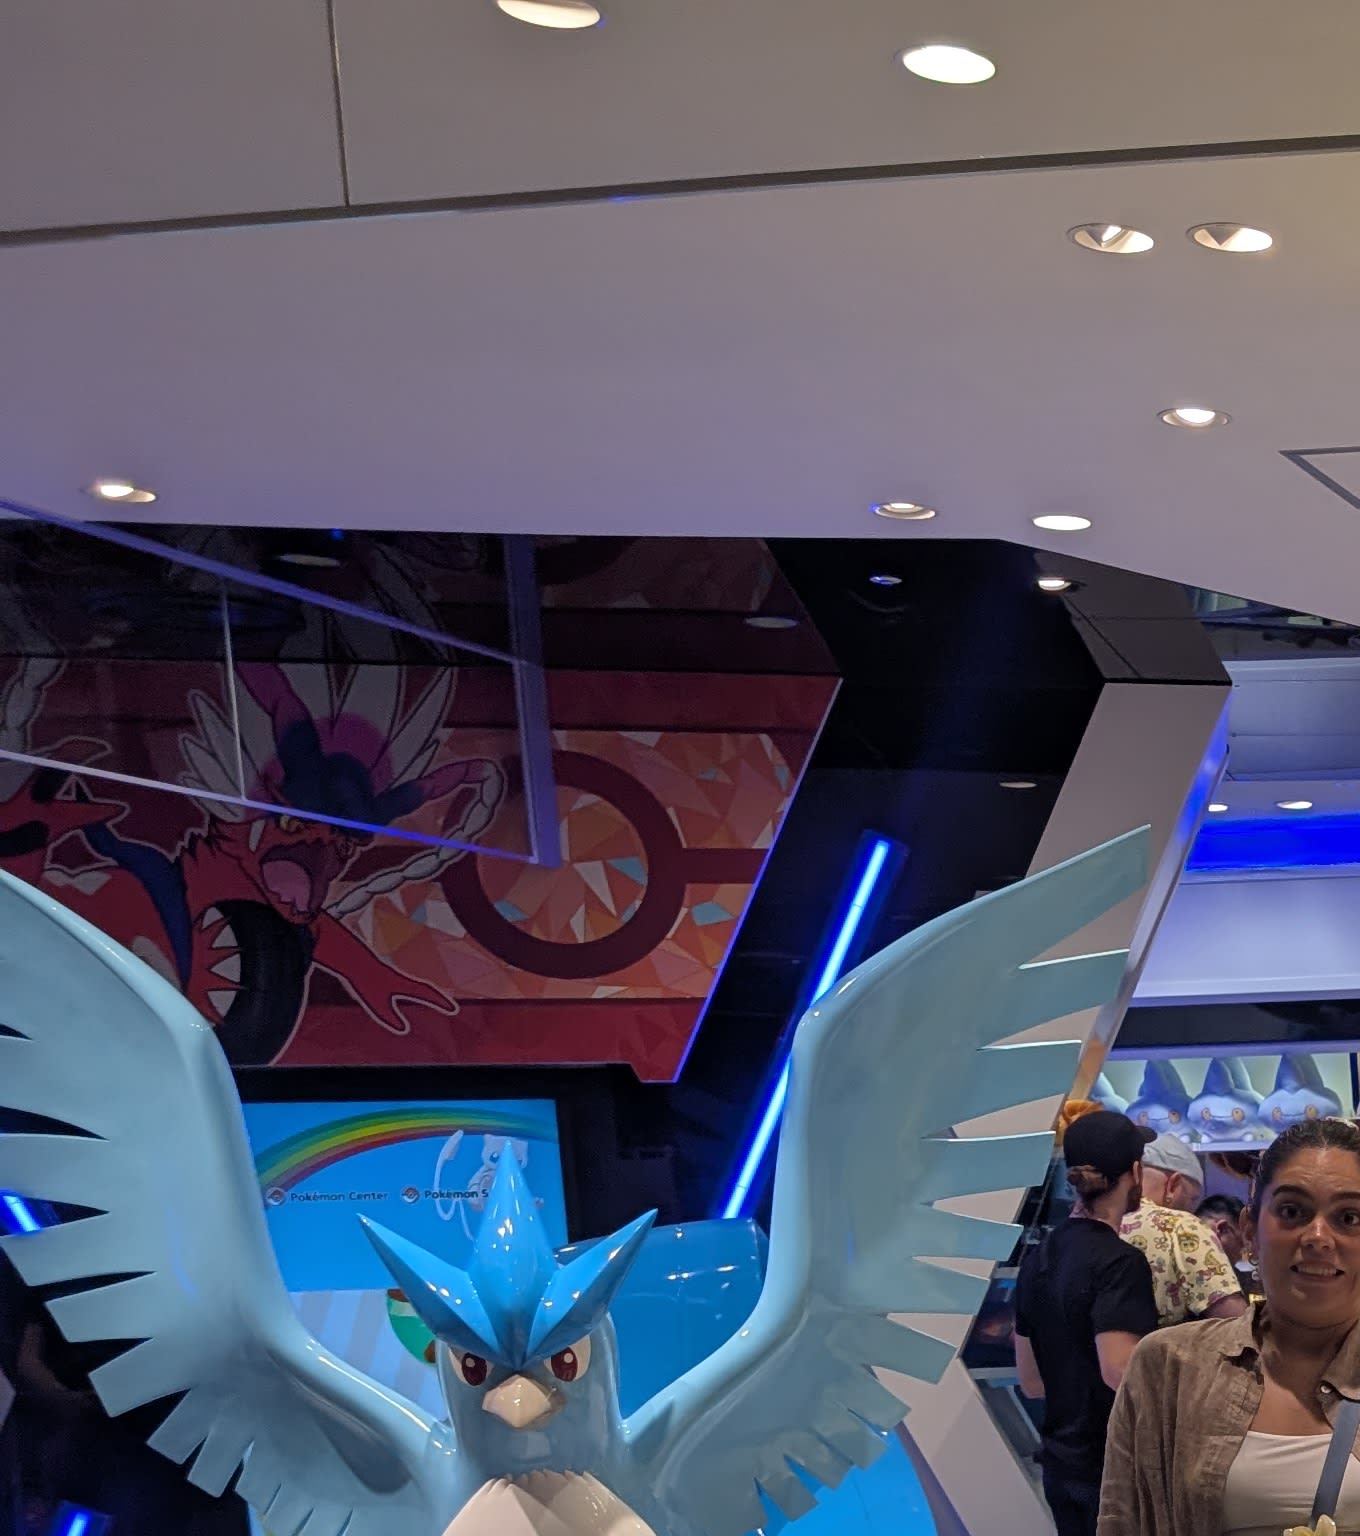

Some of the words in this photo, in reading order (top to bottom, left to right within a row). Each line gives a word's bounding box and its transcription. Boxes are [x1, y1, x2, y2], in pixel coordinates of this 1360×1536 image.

[290, 1191, 346, 1202] Pokémon
[349, 1191, 389, 1201] Center
[424, 1189, 479, 1200] Pokémon
